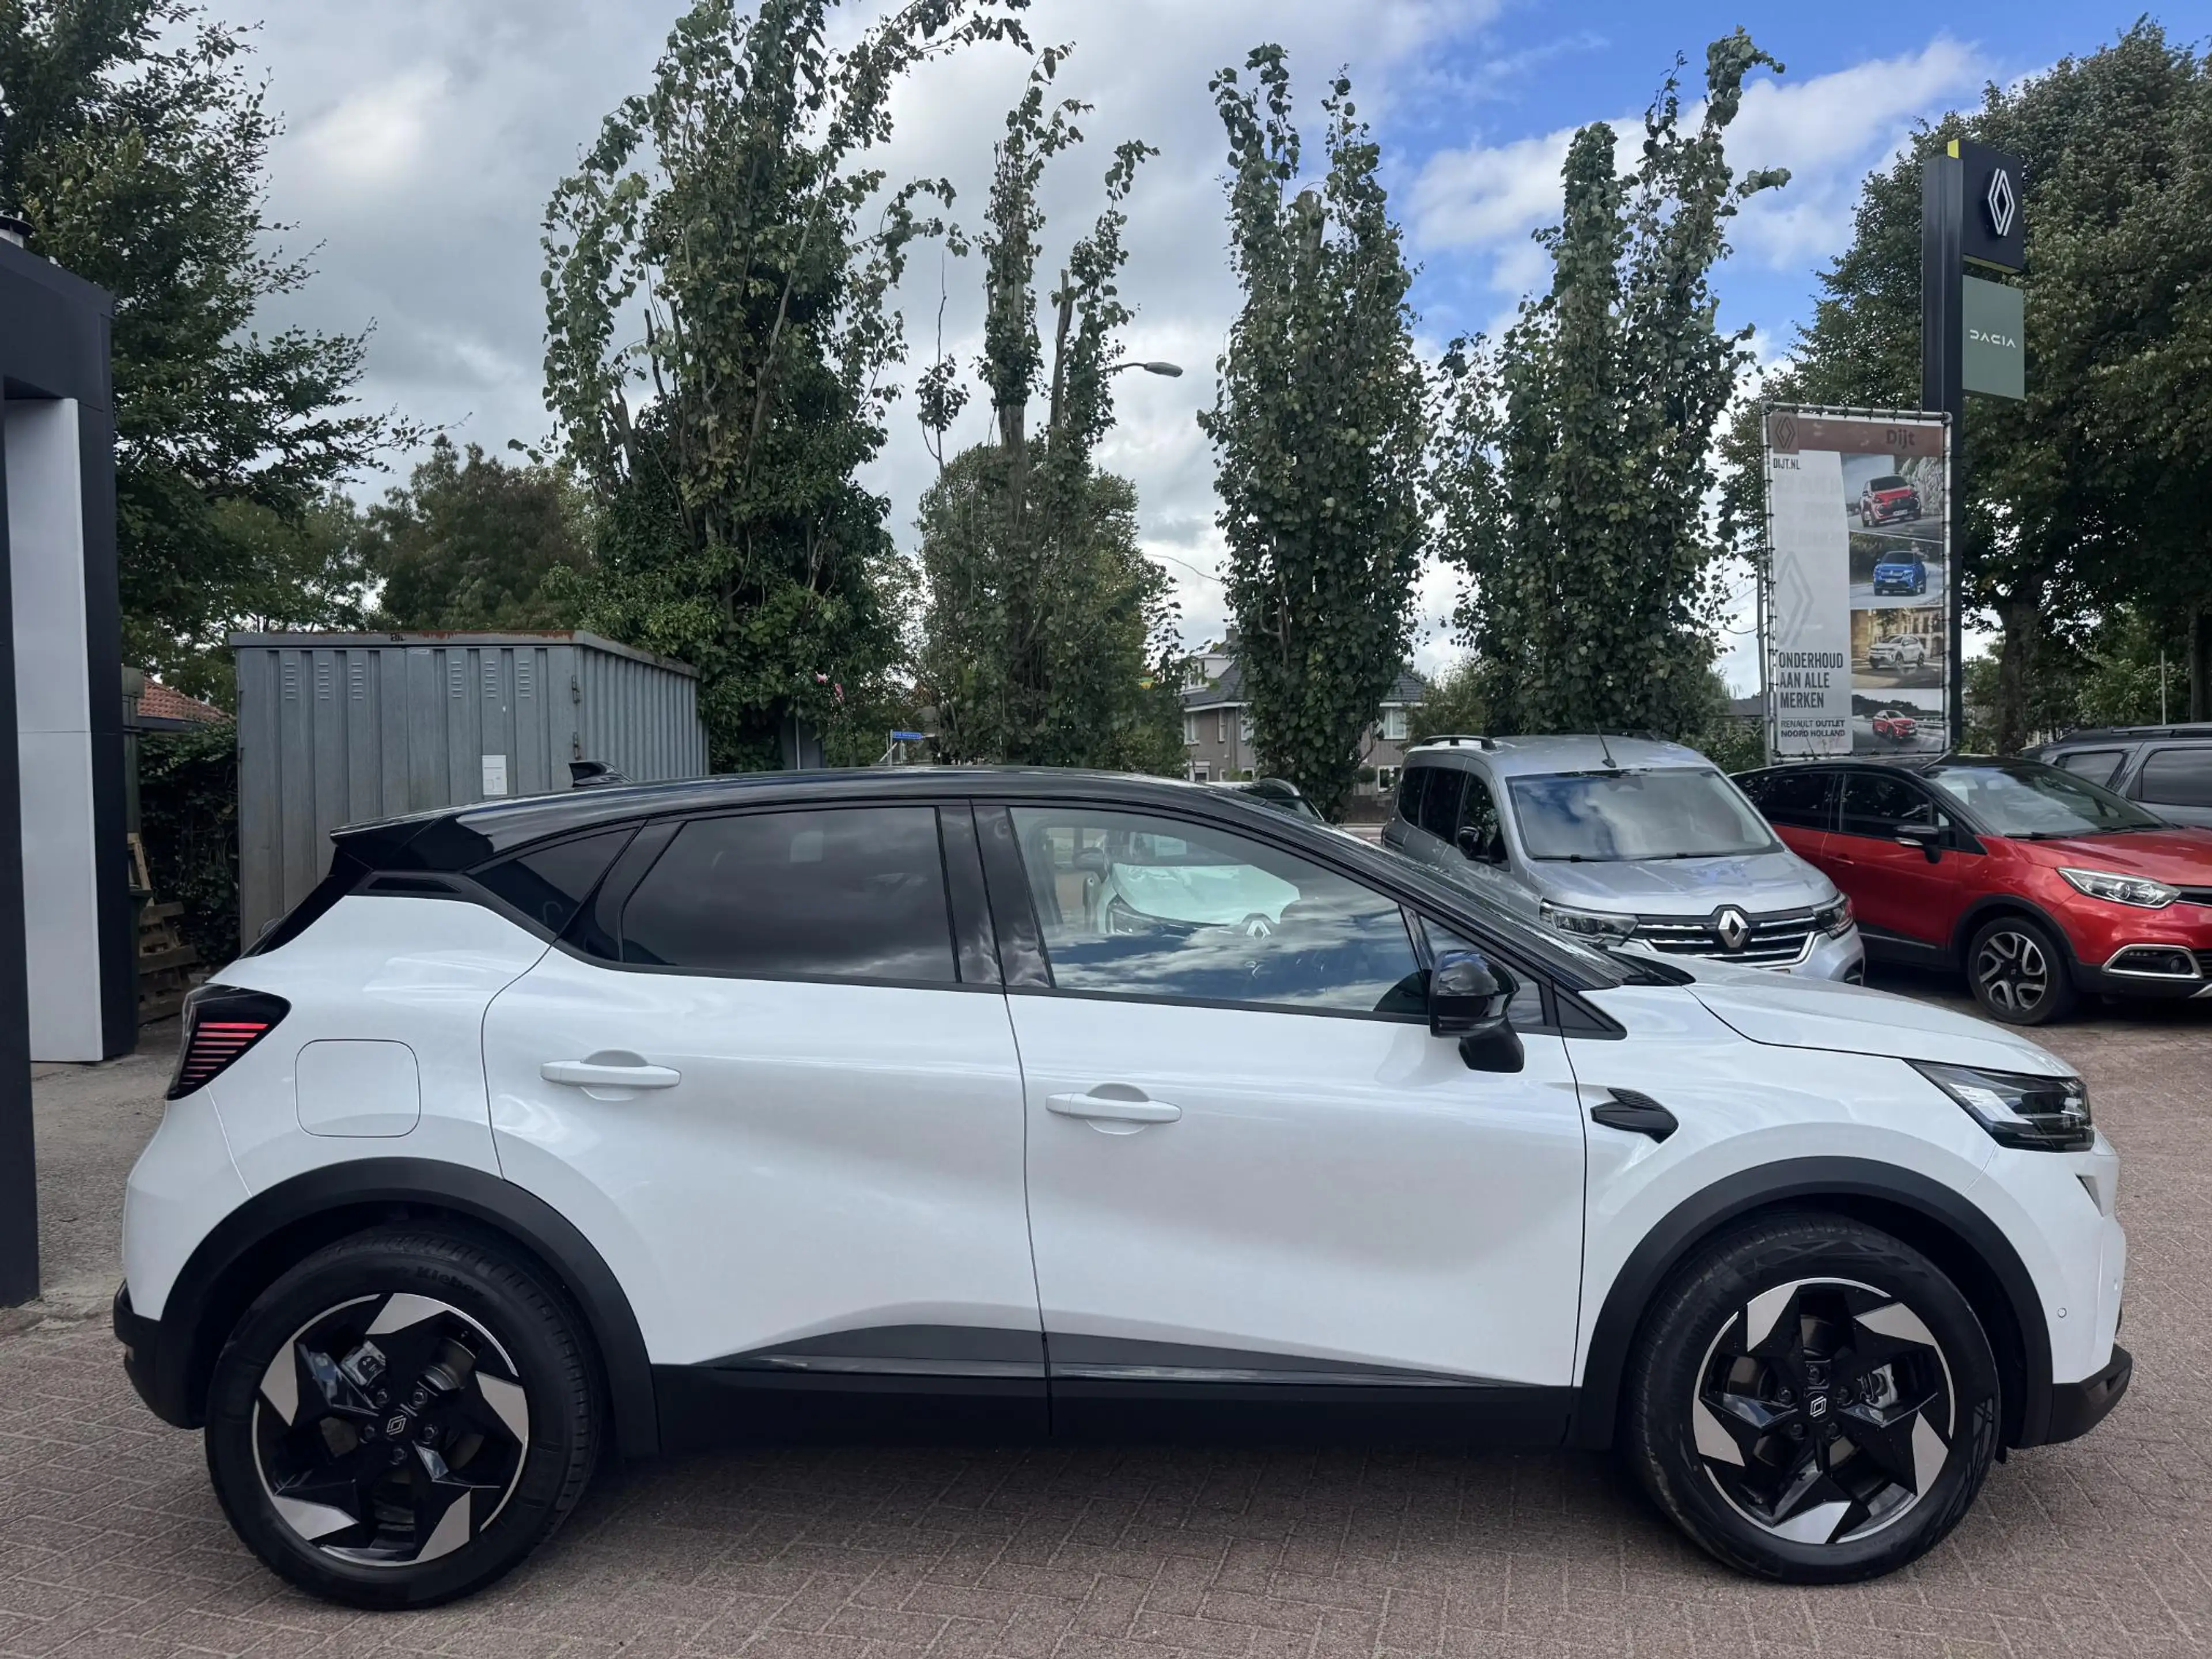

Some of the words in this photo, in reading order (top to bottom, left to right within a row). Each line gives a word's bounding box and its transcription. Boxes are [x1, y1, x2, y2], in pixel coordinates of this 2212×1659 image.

[1970, 329, 2016, 348] DACIA
[1887, 429, 1915, 449] Dijt
[1773, 458, 1800, 469] DIJT.NL
[1779, 652, 1843, 668] ONDERHOUD
[1780, 672, 1801, 688] AAN
[1805, 672, 1830, 688] ALLE
[1780, 692, 1824, 708] MERKEN
[1781, 720, 1813, 728] RENAULT
